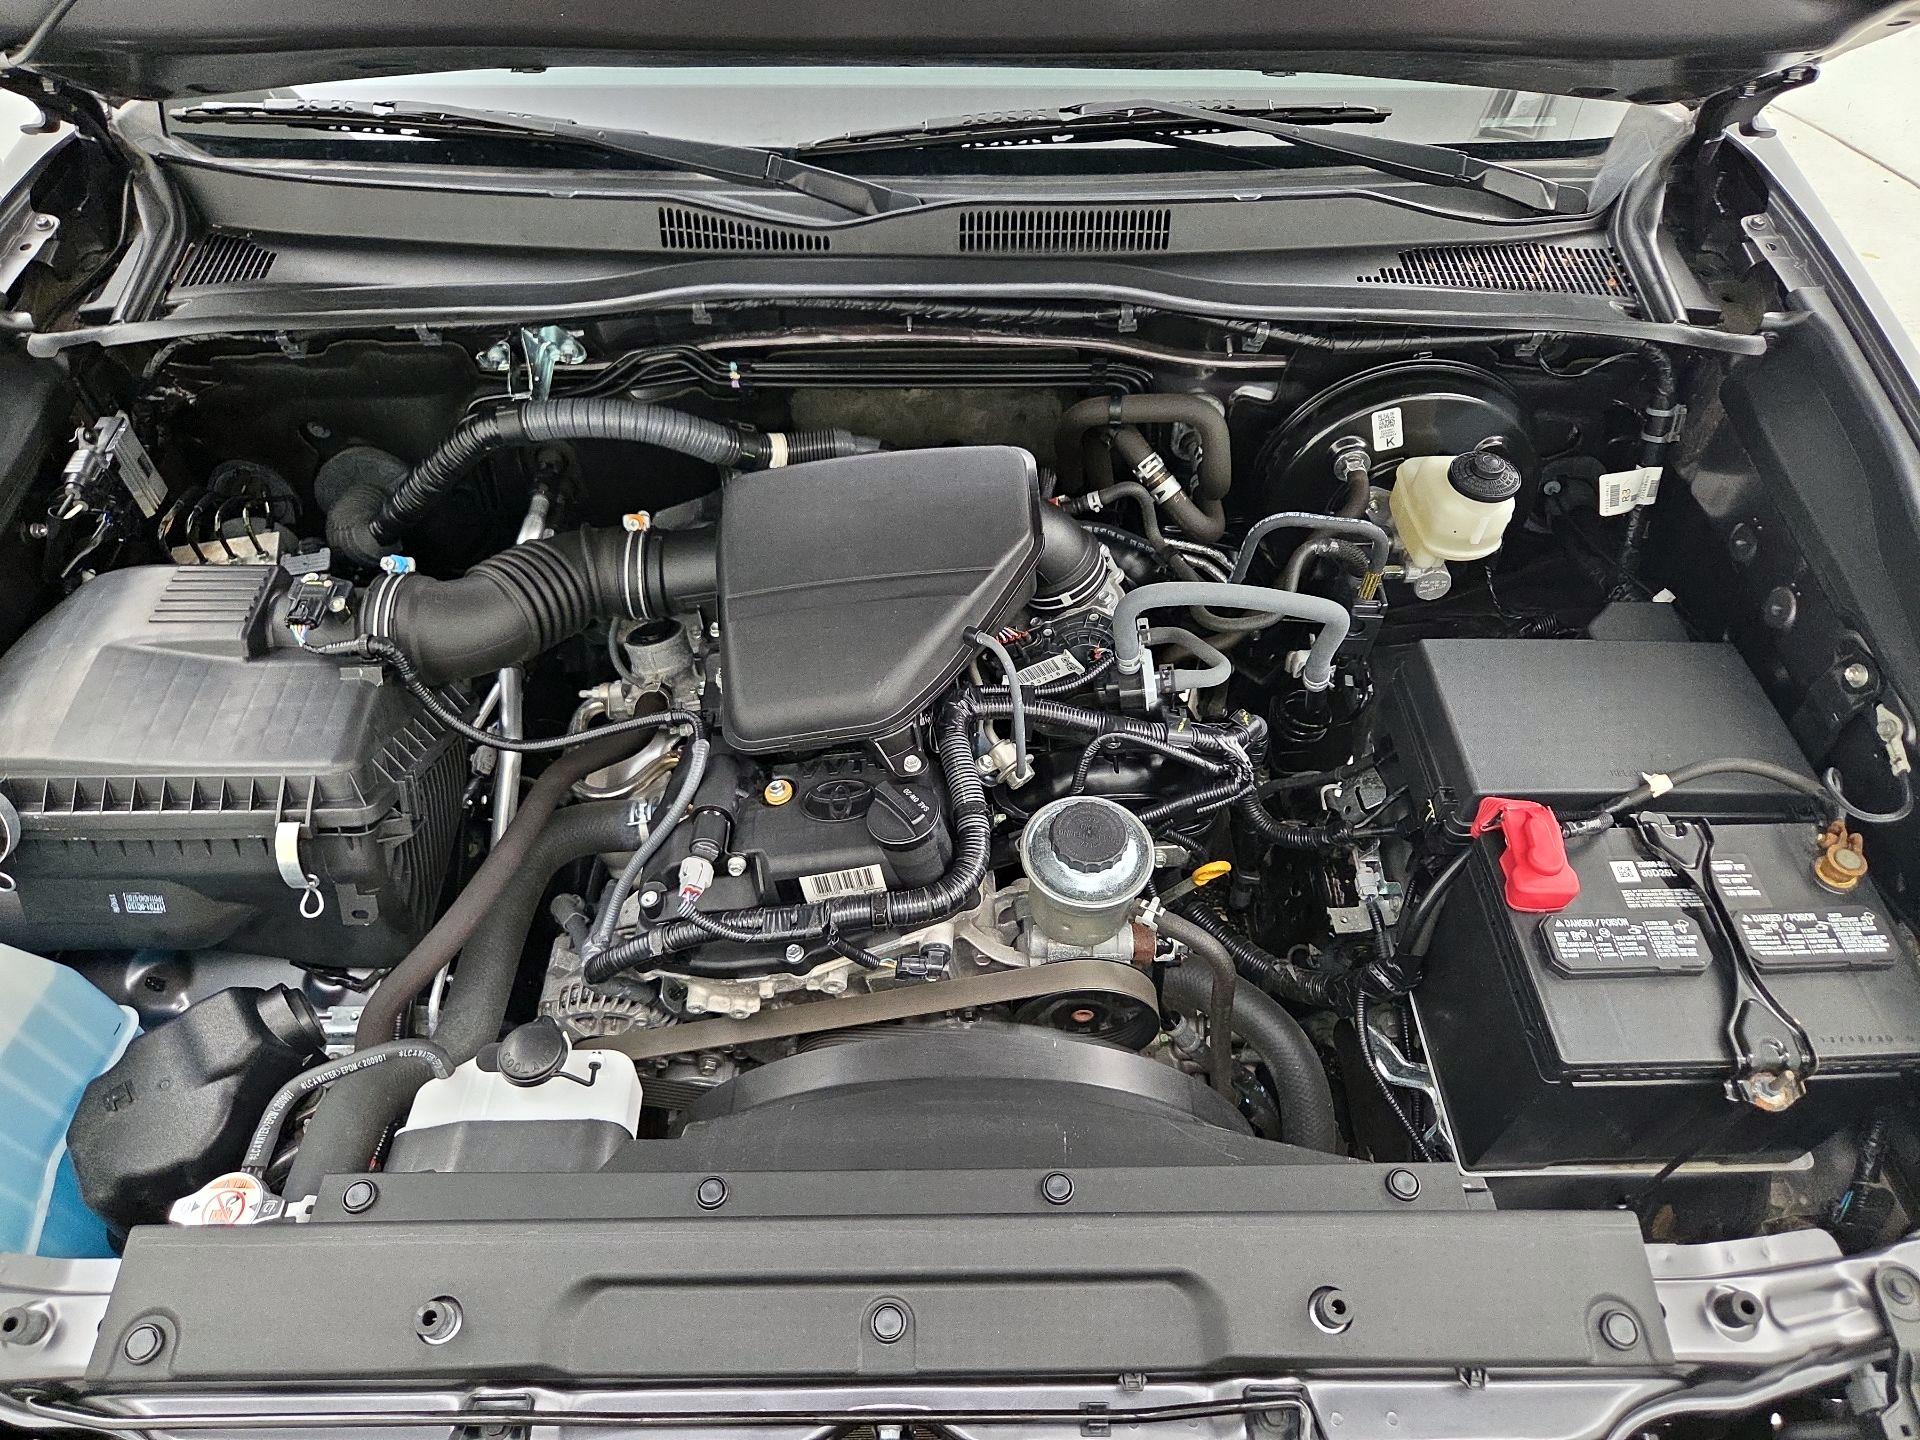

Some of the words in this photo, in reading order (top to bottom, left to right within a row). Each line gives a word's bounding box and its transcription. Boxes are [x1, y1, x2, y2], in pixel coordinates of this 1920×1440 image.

[1386, 436, 1395, 447] K
[917, 800, 930, 812] SAE
[1640, 868, 1678, 877] 80D26L
[1563, 918, 1595, 928] DANGER
[1600, 917, 1630, 927] POISON
[1751, 912, 1782, 922] DANGER
[1788, 912, 1818, 922] POISON
